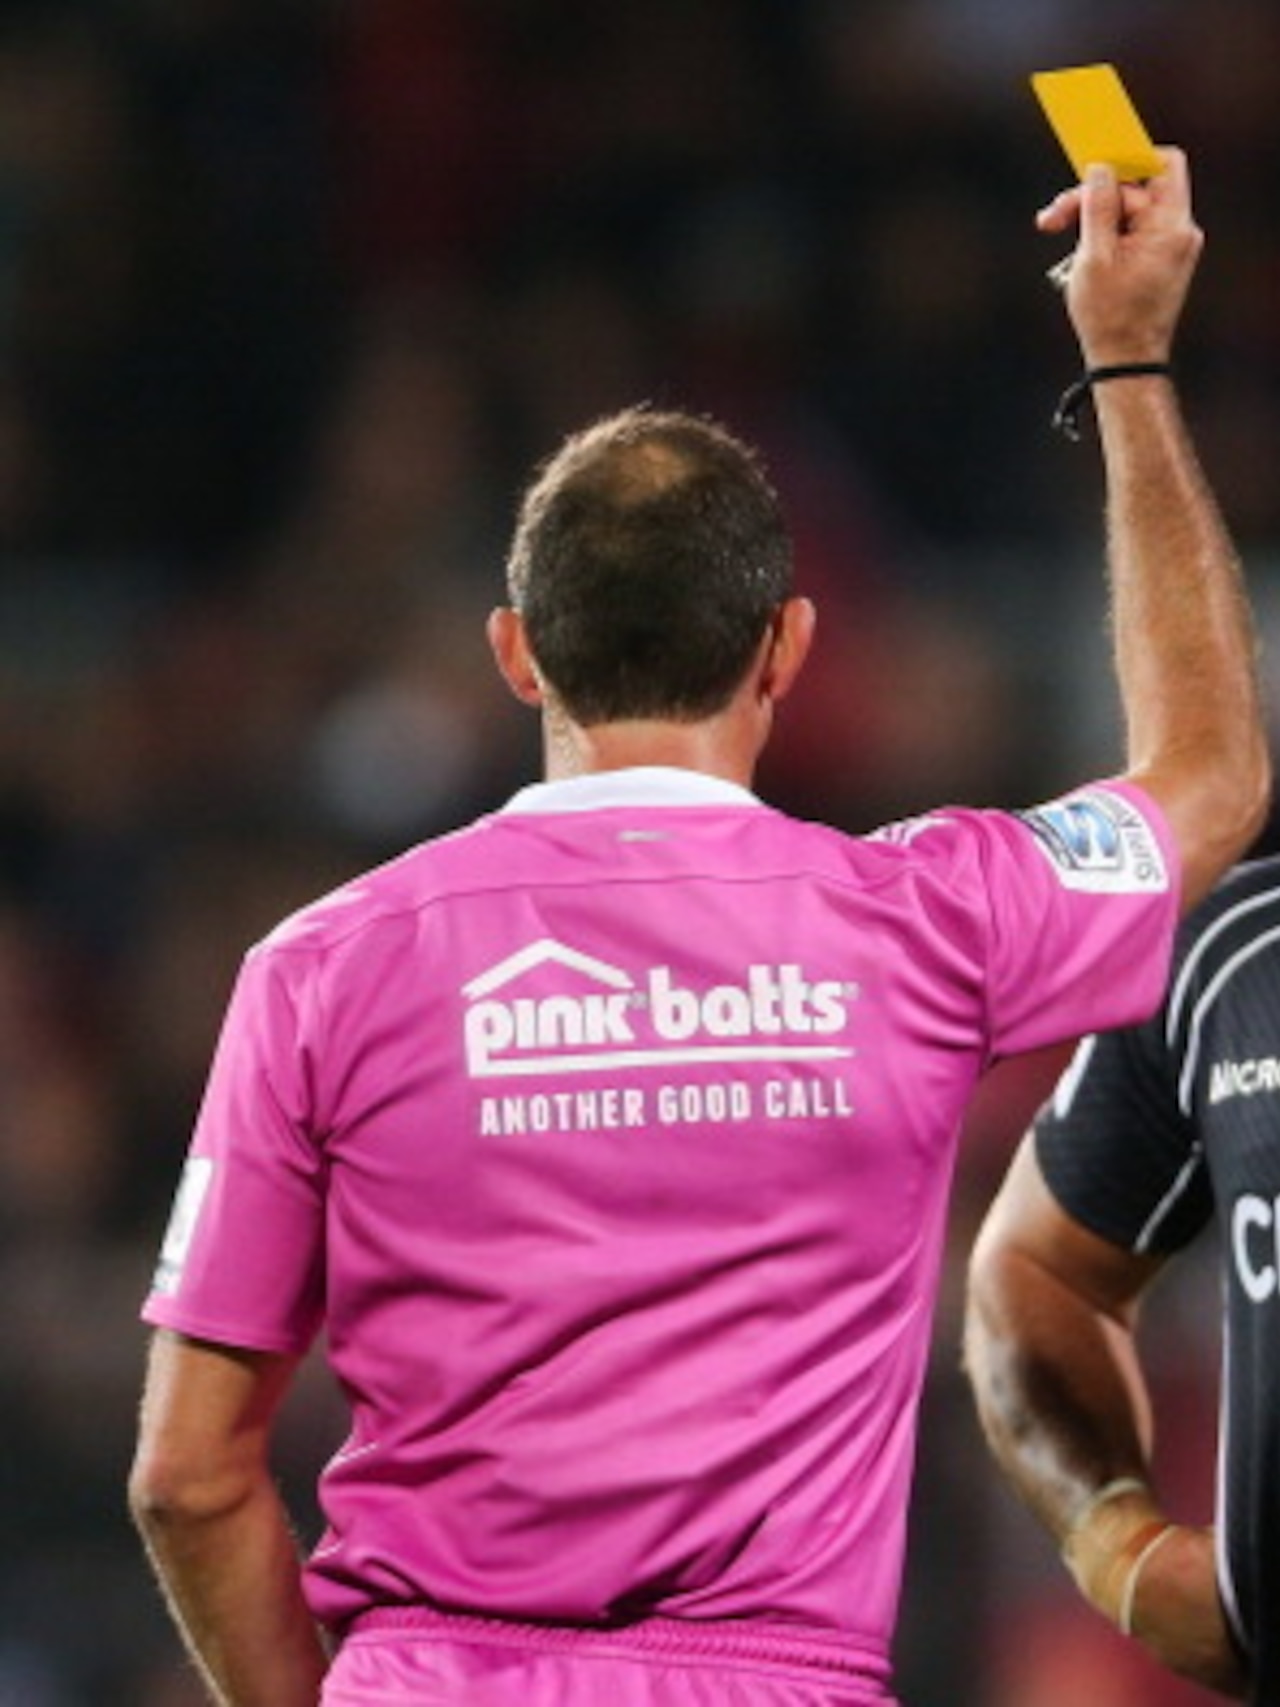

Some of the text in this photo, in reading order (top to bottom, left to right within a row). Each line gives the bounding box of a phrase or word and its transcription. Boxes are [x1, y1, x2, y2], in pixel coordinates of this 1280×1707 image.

[480, 1077, 855, 1136] ANOTHER GOOD CALL
